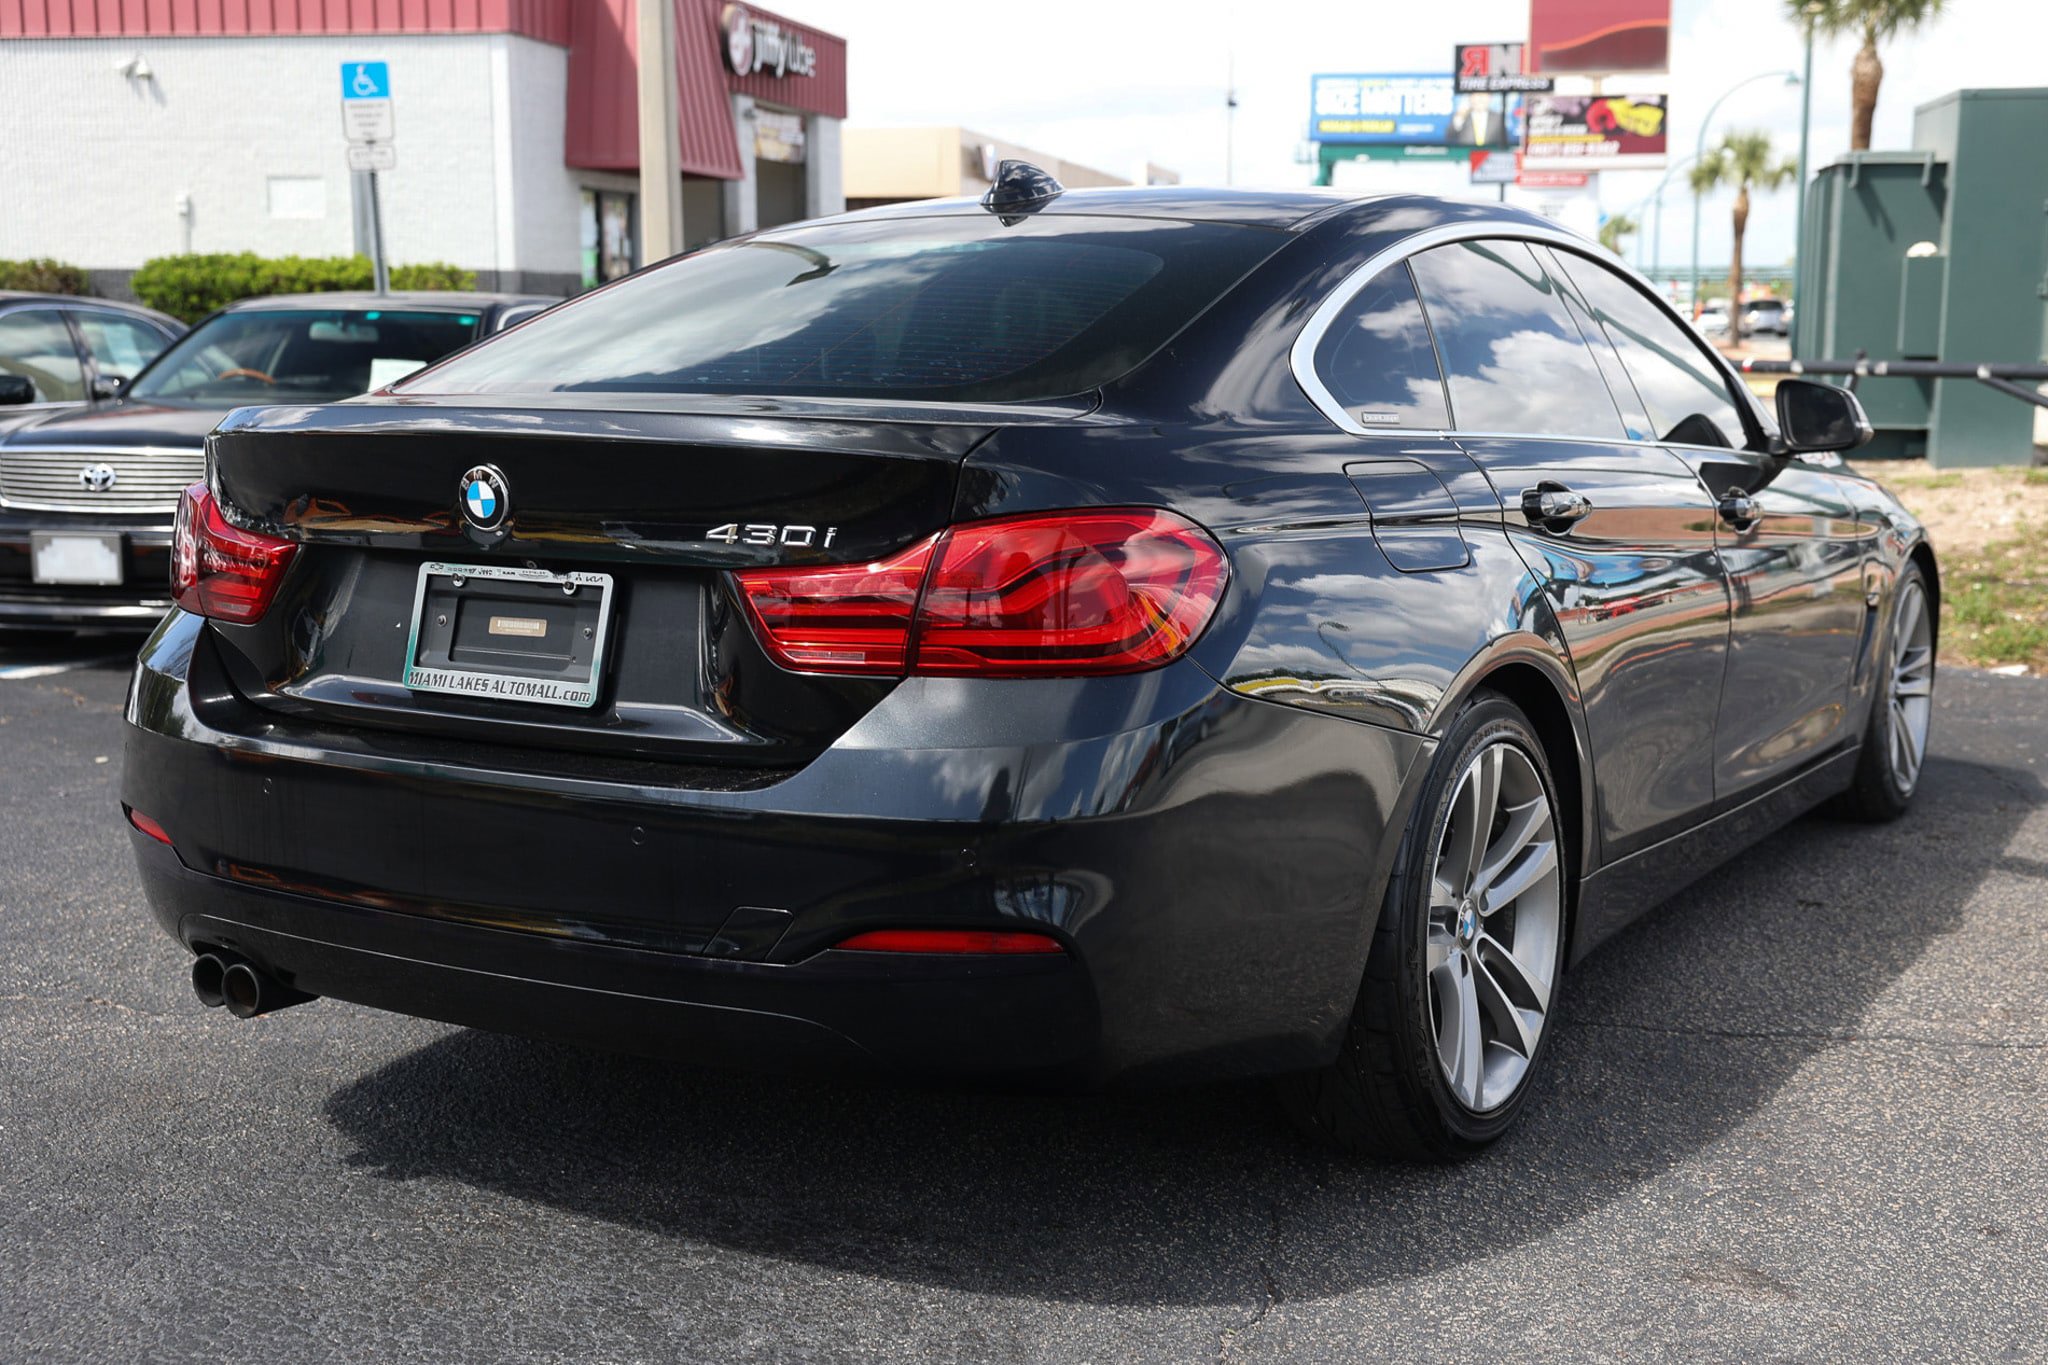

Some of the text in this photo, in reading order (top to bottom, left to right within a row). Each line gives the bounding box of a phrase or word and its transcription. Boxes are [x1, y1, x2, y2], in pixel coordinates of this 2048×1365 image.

[461, 469, 499, 490] BMW
[706, 523, 838, 548] 430i
[409, 671, 447, 687] MIAMI
[448, 675, 489, 692] LAKES
